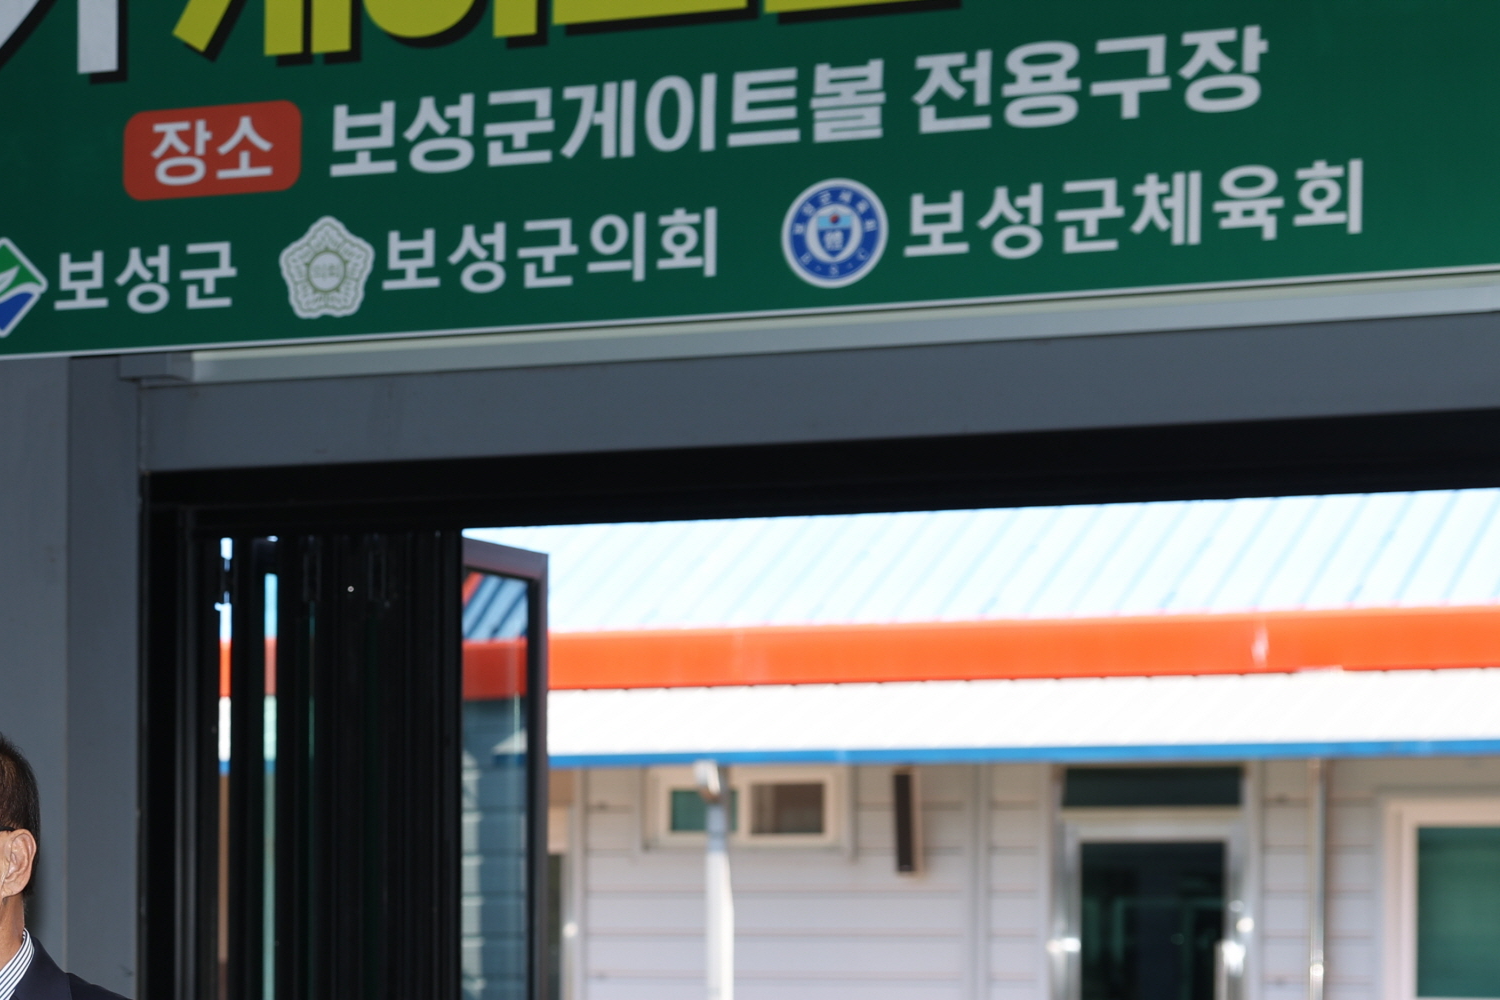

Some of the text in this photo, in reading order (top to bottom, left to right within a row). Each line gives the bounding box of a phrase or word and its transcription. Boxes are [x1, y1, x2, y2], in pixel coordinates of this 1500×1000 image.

[150, 115, 275, 187] 장소
[329, 59, 886, 177] 보성군게이트볼
[912, 25, 1270, 134] 전용구장
[54, 242, 238, 314] 보성군
[382, 206, 719, 294] 보성군의회
[903, 159, 1365, 259] 보성군체육회
